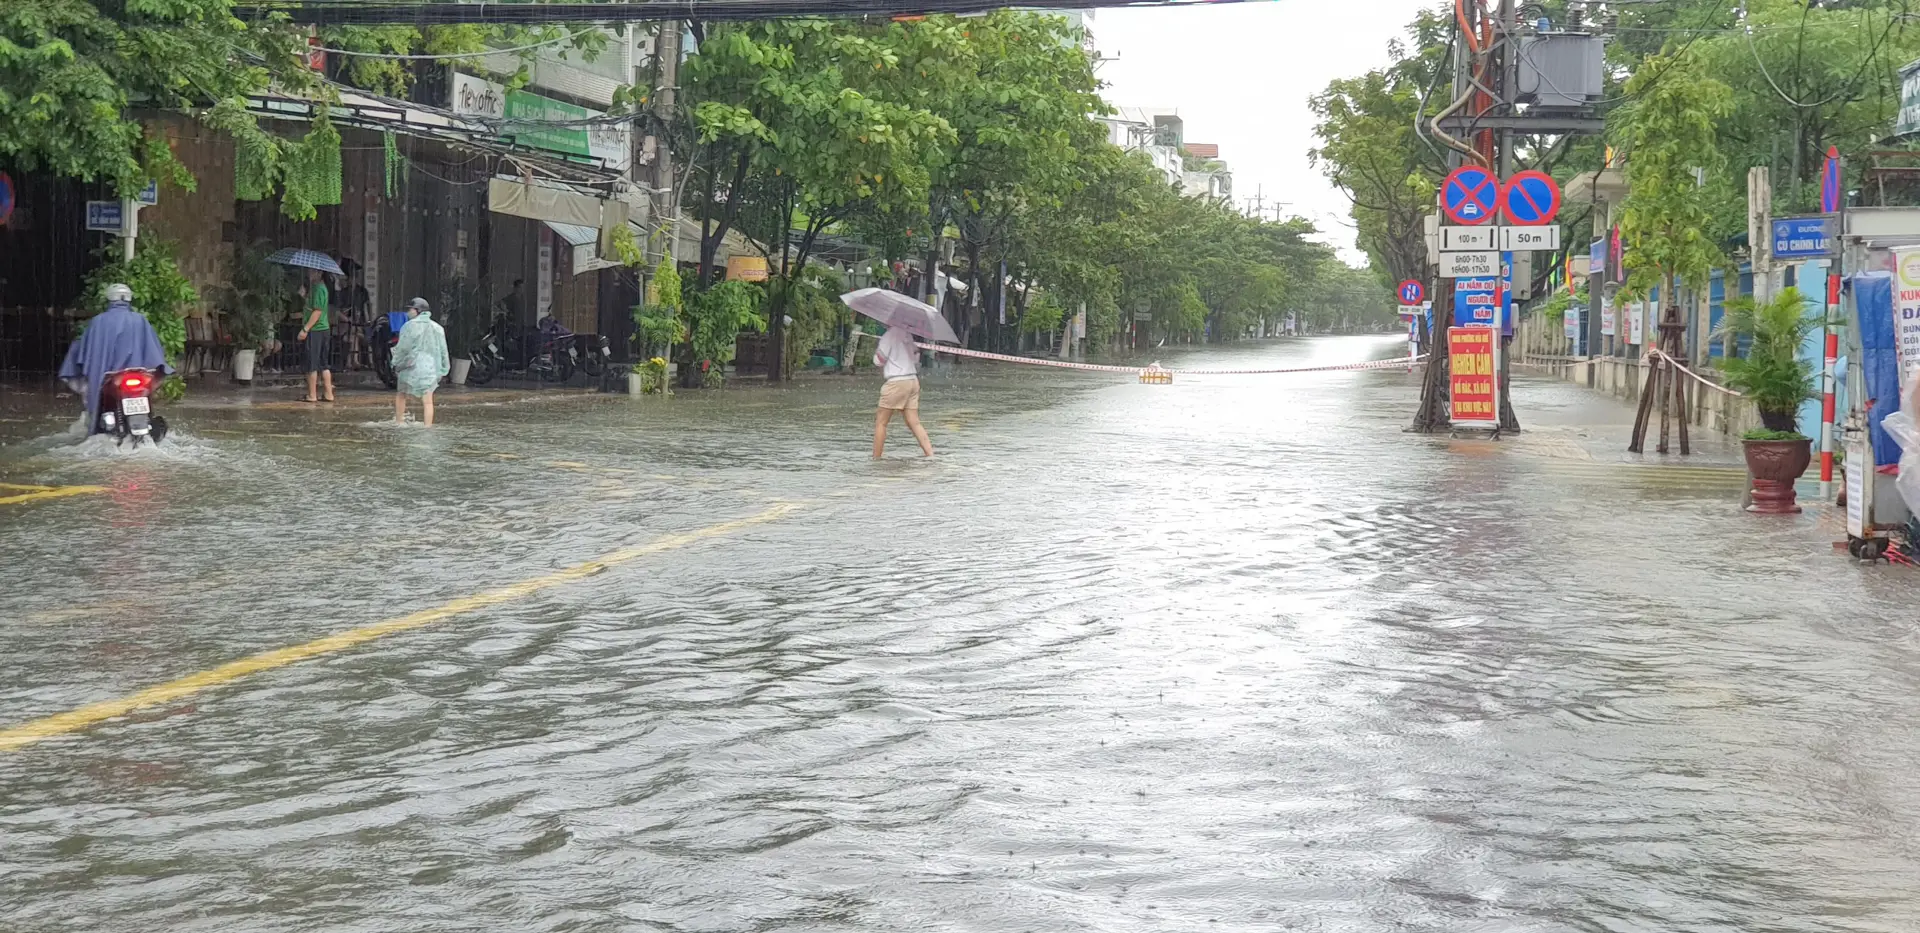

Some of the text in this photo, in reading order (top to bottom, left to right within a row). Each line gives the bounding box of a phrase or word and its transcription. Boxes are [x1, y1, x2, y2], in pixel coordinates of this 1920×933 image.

[1458, 234, 1470, 243] 100
[1518, 233, 1542, 243] 50 m
[1789, 236, 1814, 251] CHÍNH
[1452, 345, 1491, 375] NGHIÊM CẤM
